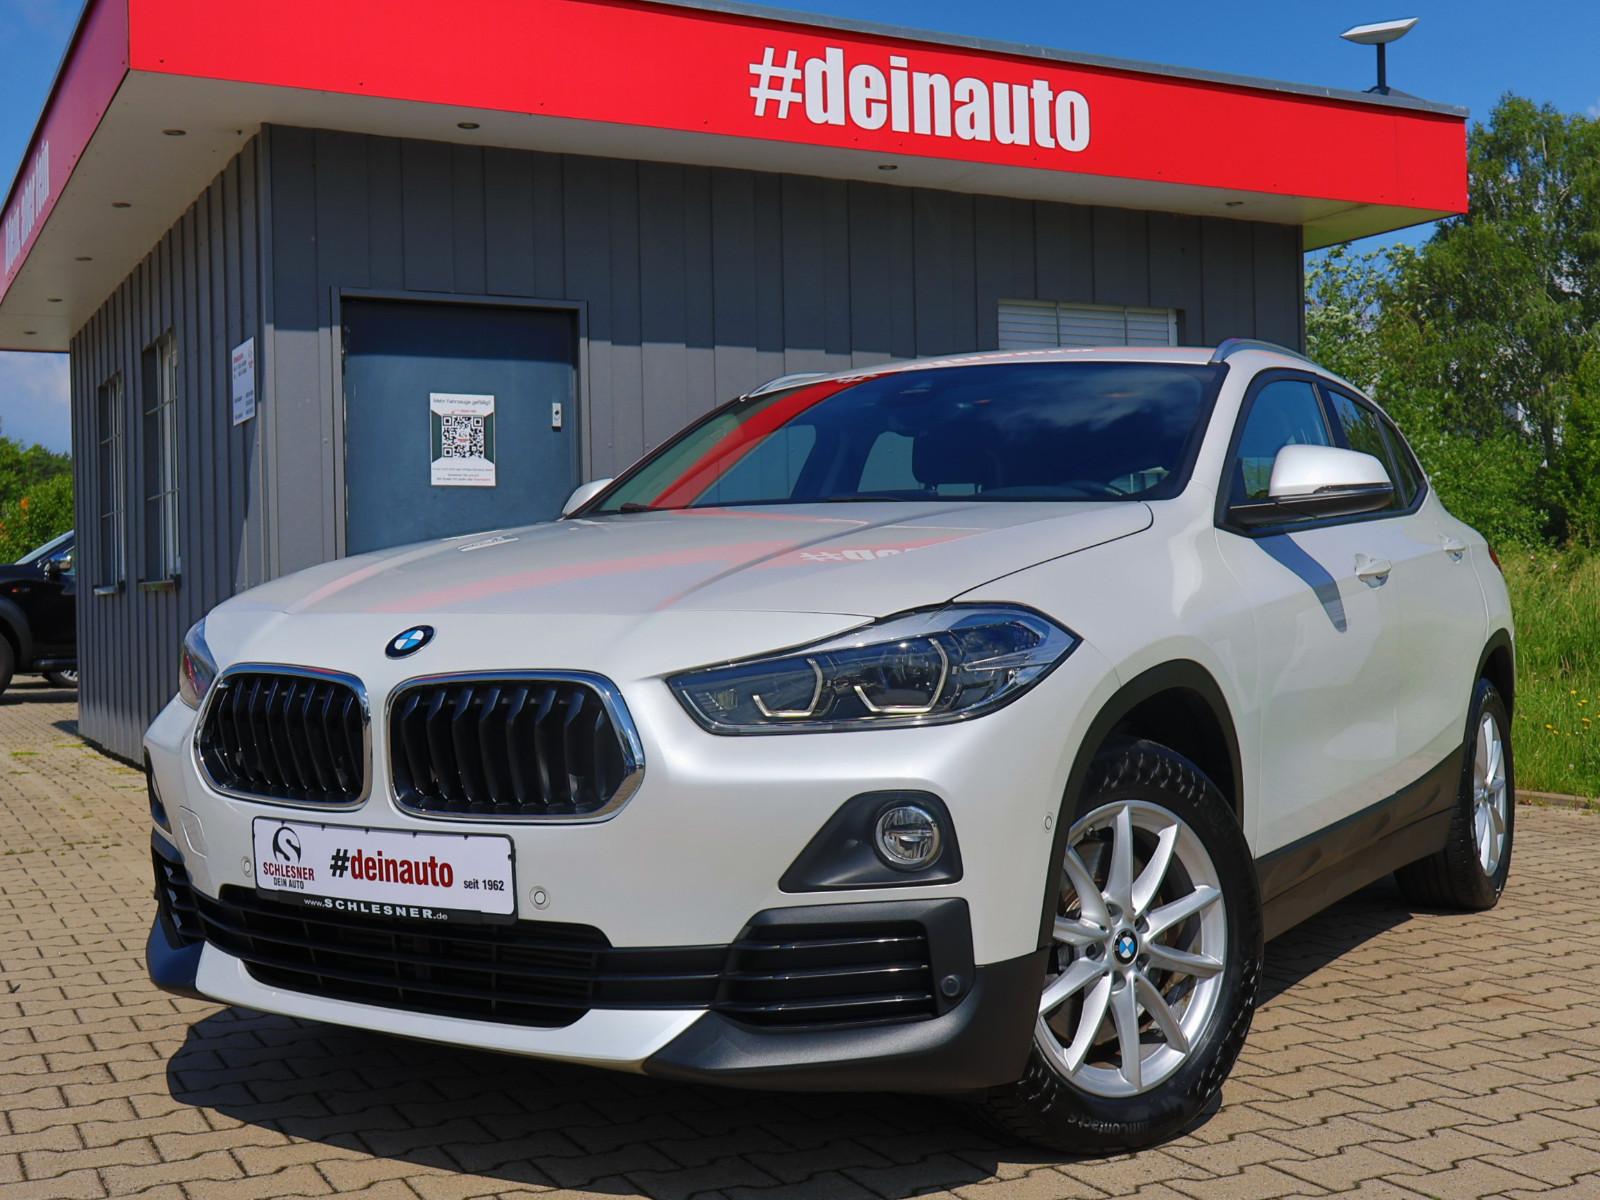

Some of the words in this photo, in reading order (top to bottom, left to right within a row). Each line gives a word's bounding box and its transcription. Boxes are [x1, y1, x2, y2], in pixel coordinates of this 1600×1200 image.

[749, 46, 1091, 153] #deinauto
[263, 861, 315, 881] SCHLESNER
[329, 848, 454, 888] #deinauto
[273, 877, 288, 888] DEIN
[288, 879, 305, 890] AUTO
[463, 878, 480, 890] seit
[481, 879, 505, 892] 1962
[303, 898, 448, 920] www.SCHLESNER.de
